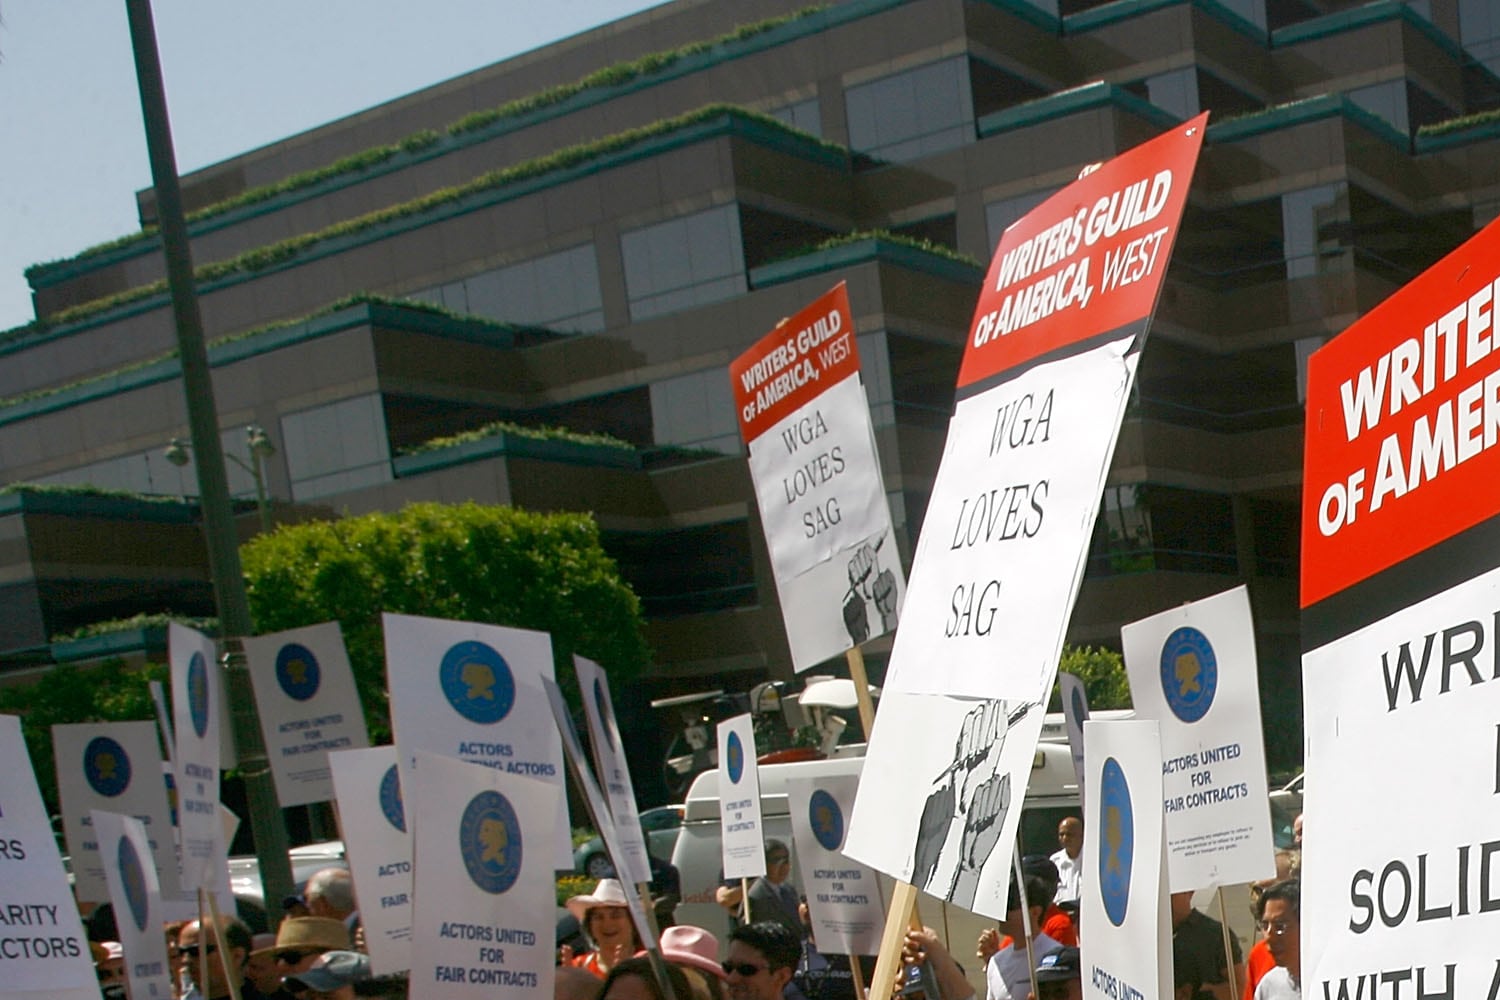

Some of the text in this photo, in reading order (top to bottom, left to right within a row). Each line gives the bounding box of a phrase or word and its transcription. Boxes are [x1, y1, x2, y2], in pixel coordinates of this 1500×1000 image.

[996, 169, 1172, 292] WRITERS GUILD
[973, 227, 1168, 348] OF AMERICA, WEST
[741, 309, 841, 393] WRITERS GUILD
[743, 332, 851, 423] OF AMERICA, WEST
[782, 410, 828, 455] WGA
[988, 387, 1055, 458] WGA
[783, 447, 845, 504] LOVES
[803, 497, 842, 538] SAG
[950, 479, 1049, 551] LOVES
[1317, 467, 1367, 536] OF
[943, 579, 1002, 639] SAG
[459, 742, 513, 756] ACTORS
[1162, 743, 1241, 775] ACTORS UNITED
[507, 763, 556, 776] ACTORS
[1191, 771, 1212, 787] FOR
[1164, 783, 1248, 813] FAIR CONTRACTS
[379, 861, 411, 876] ACTO
[0, 937, 80, 960] CTORS
[440, 922, 536, 946] ACTORS UNITED
[480, 947, 504, 963] FOR
[436, 966, 537, 988] FAIR CONTRACTS
[1092, 965, 1118, 1000] ACTORS
